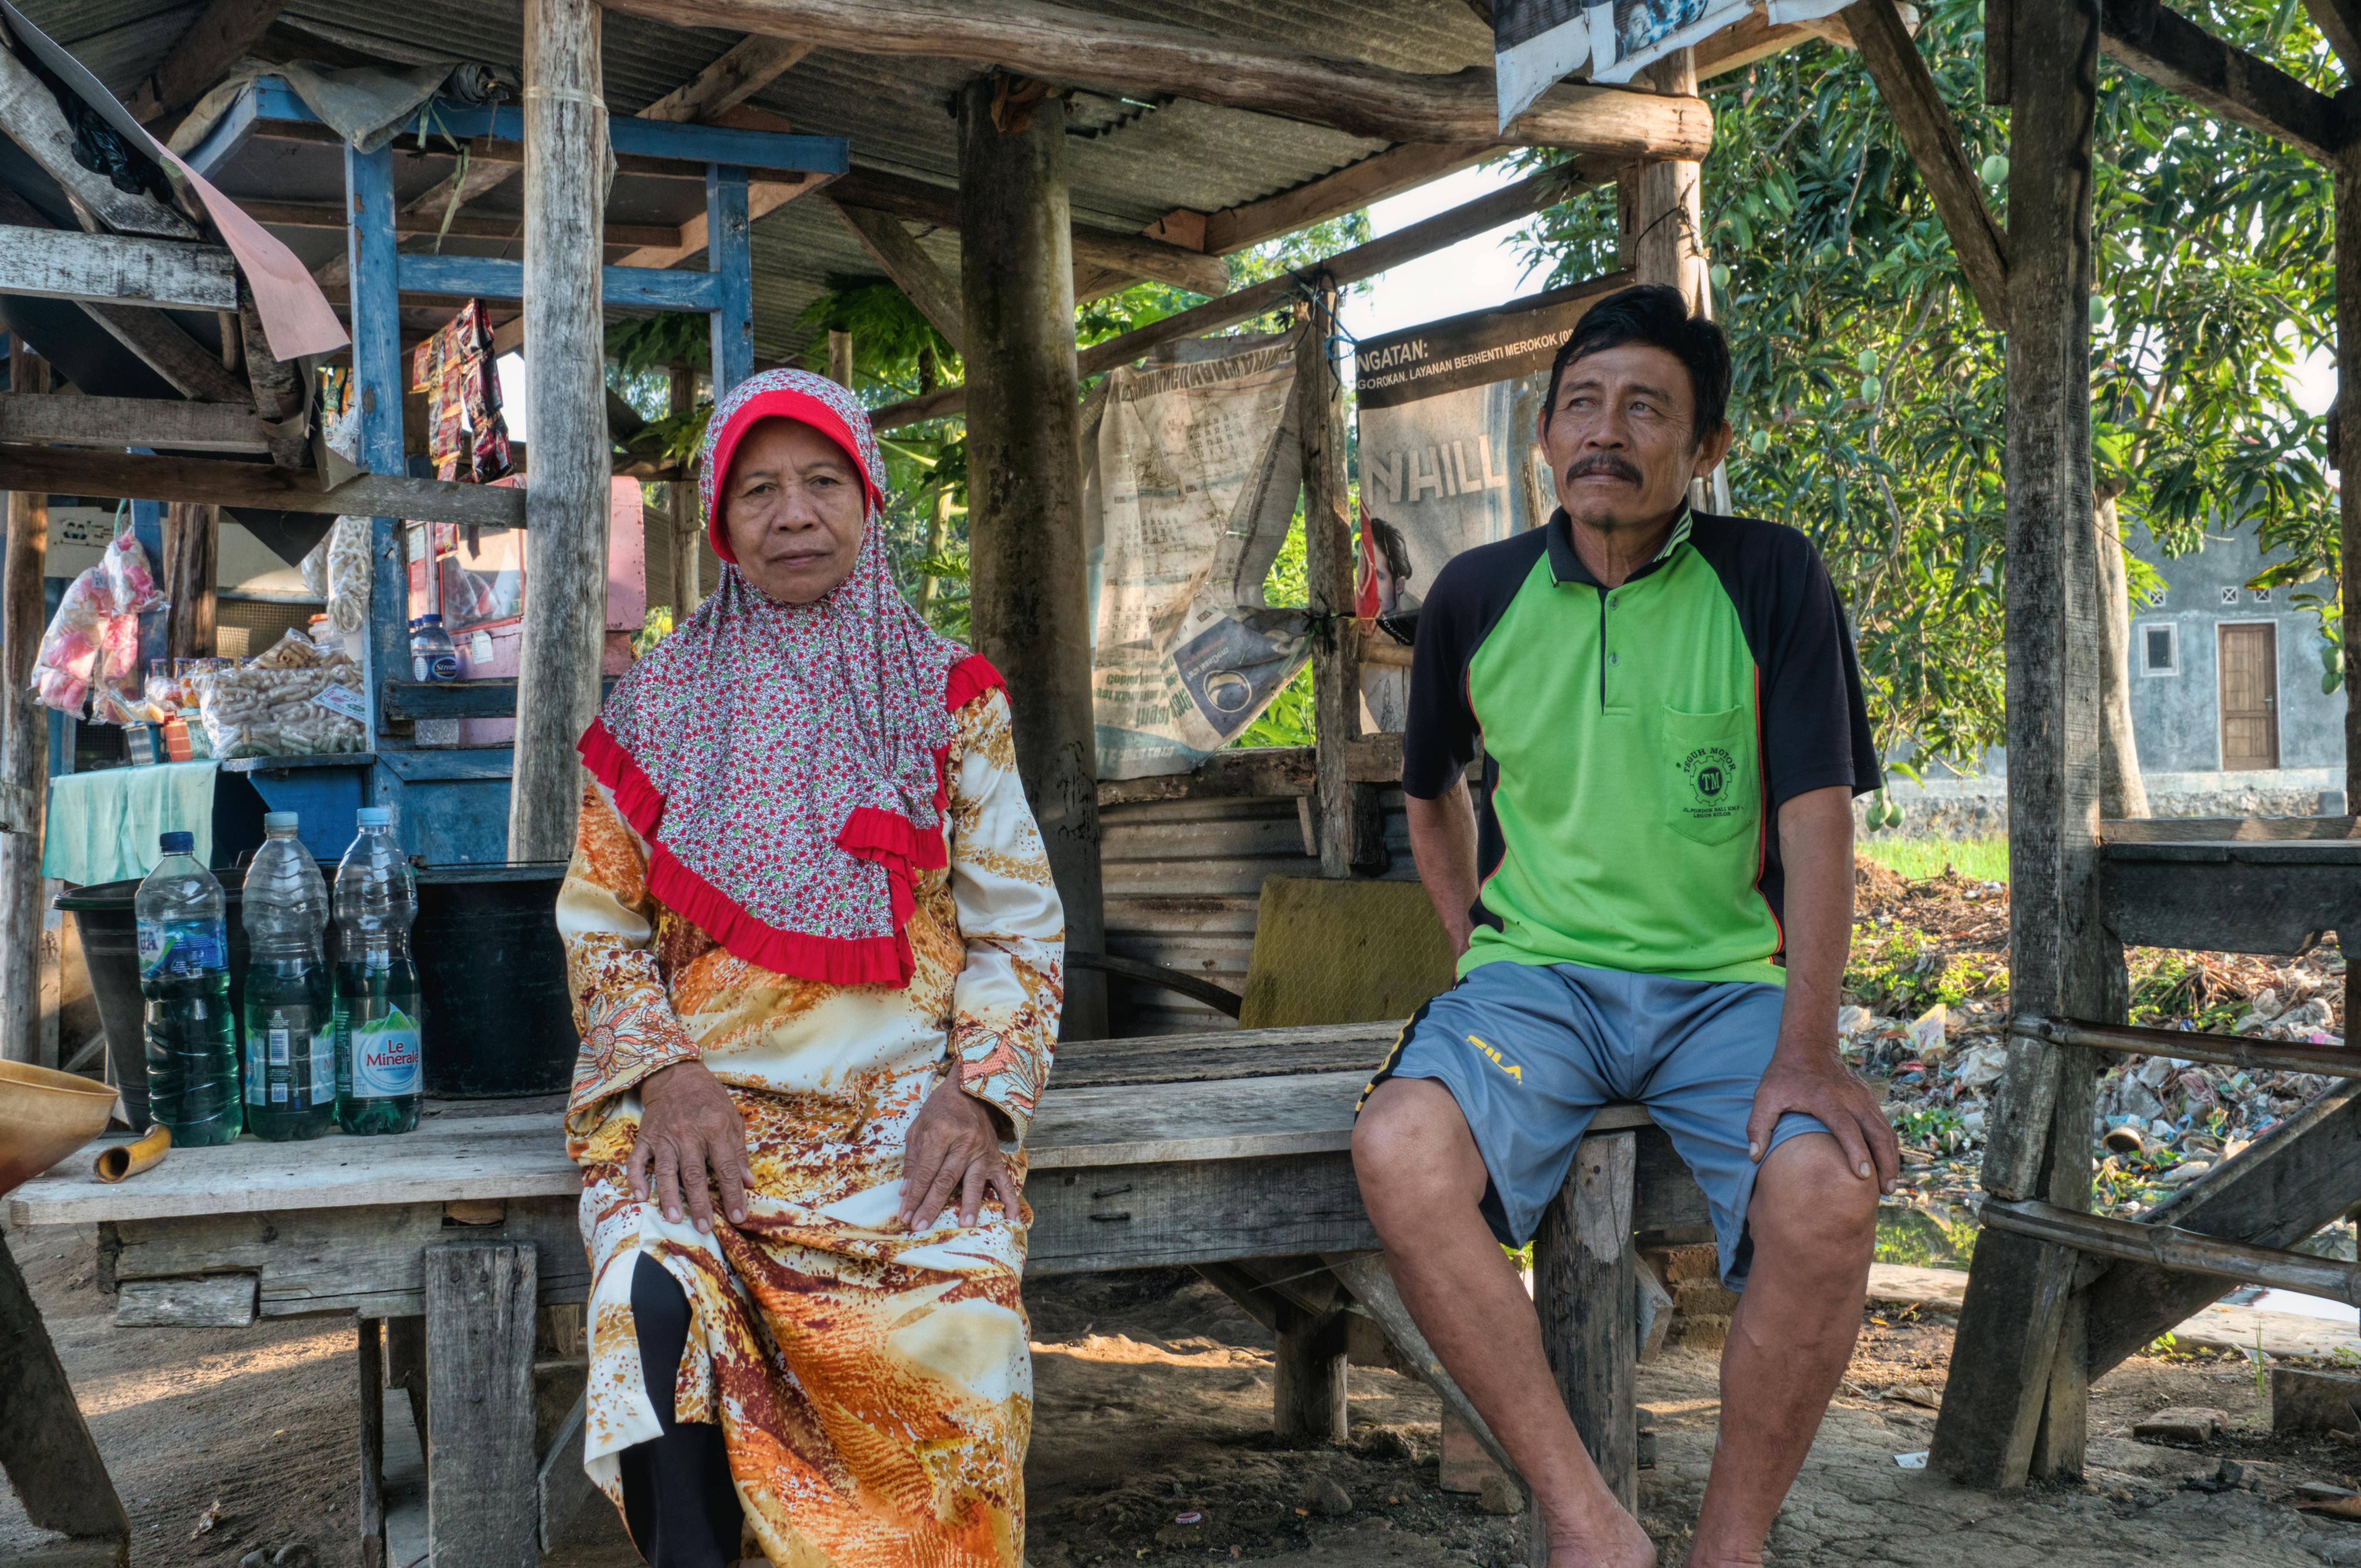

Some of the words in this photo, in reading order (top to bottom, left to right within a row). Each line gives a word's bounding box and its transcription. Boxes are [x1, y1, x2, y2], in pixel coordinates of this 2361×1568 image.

[1357, 339, 1428, 373] NGATAN:
[1357, 372, 1408, 390] GOROKAN.
[1410, 359, 1453, 381] LAYANAN
[1454, 347, 1504, 370] BERHENTI
[1505, 333, 1558, 357] MEROKOK
[1366, 435, 1507, 506] NHILL
[1684, 748, 1706, 773] TEGUH
[1710, 747, 1736, 772] MOTOR
[1702, 772, 1720, 791] TM
[366, 1050, 419, 1067] Minerale
[388, 1039, 404, 1054] Le
